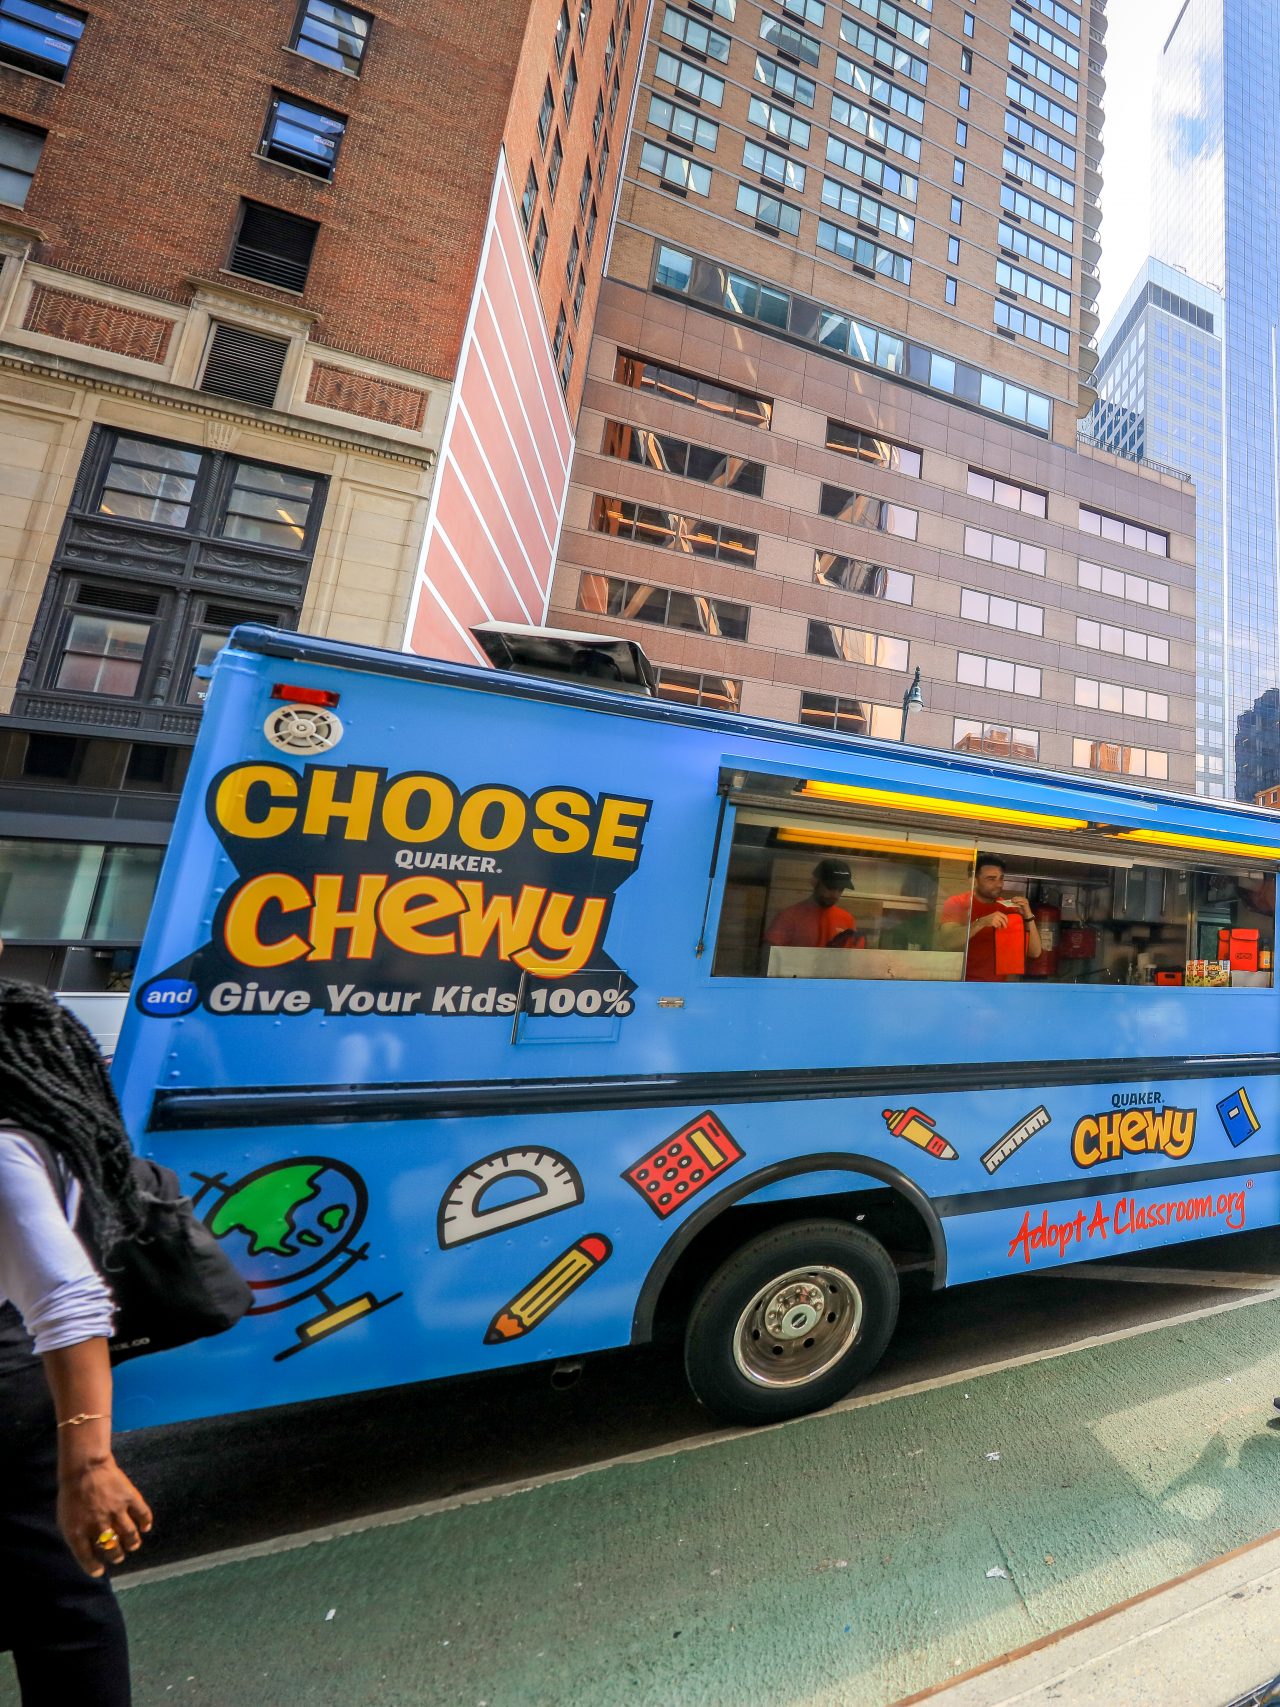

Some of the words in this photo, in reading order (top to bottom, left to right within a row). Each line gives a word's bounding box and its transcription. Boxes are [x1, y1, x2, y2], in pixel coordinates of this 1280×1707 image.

[216, 766, 647, 862] CHOOSE
[147, 989, 193, 1004] and
[209, 982, 311, 1012] Give
[327, 984, 421, 1013] Your
[432, 986, 517, 1013] Kids
[531, 988, 631, 1014] 100%
